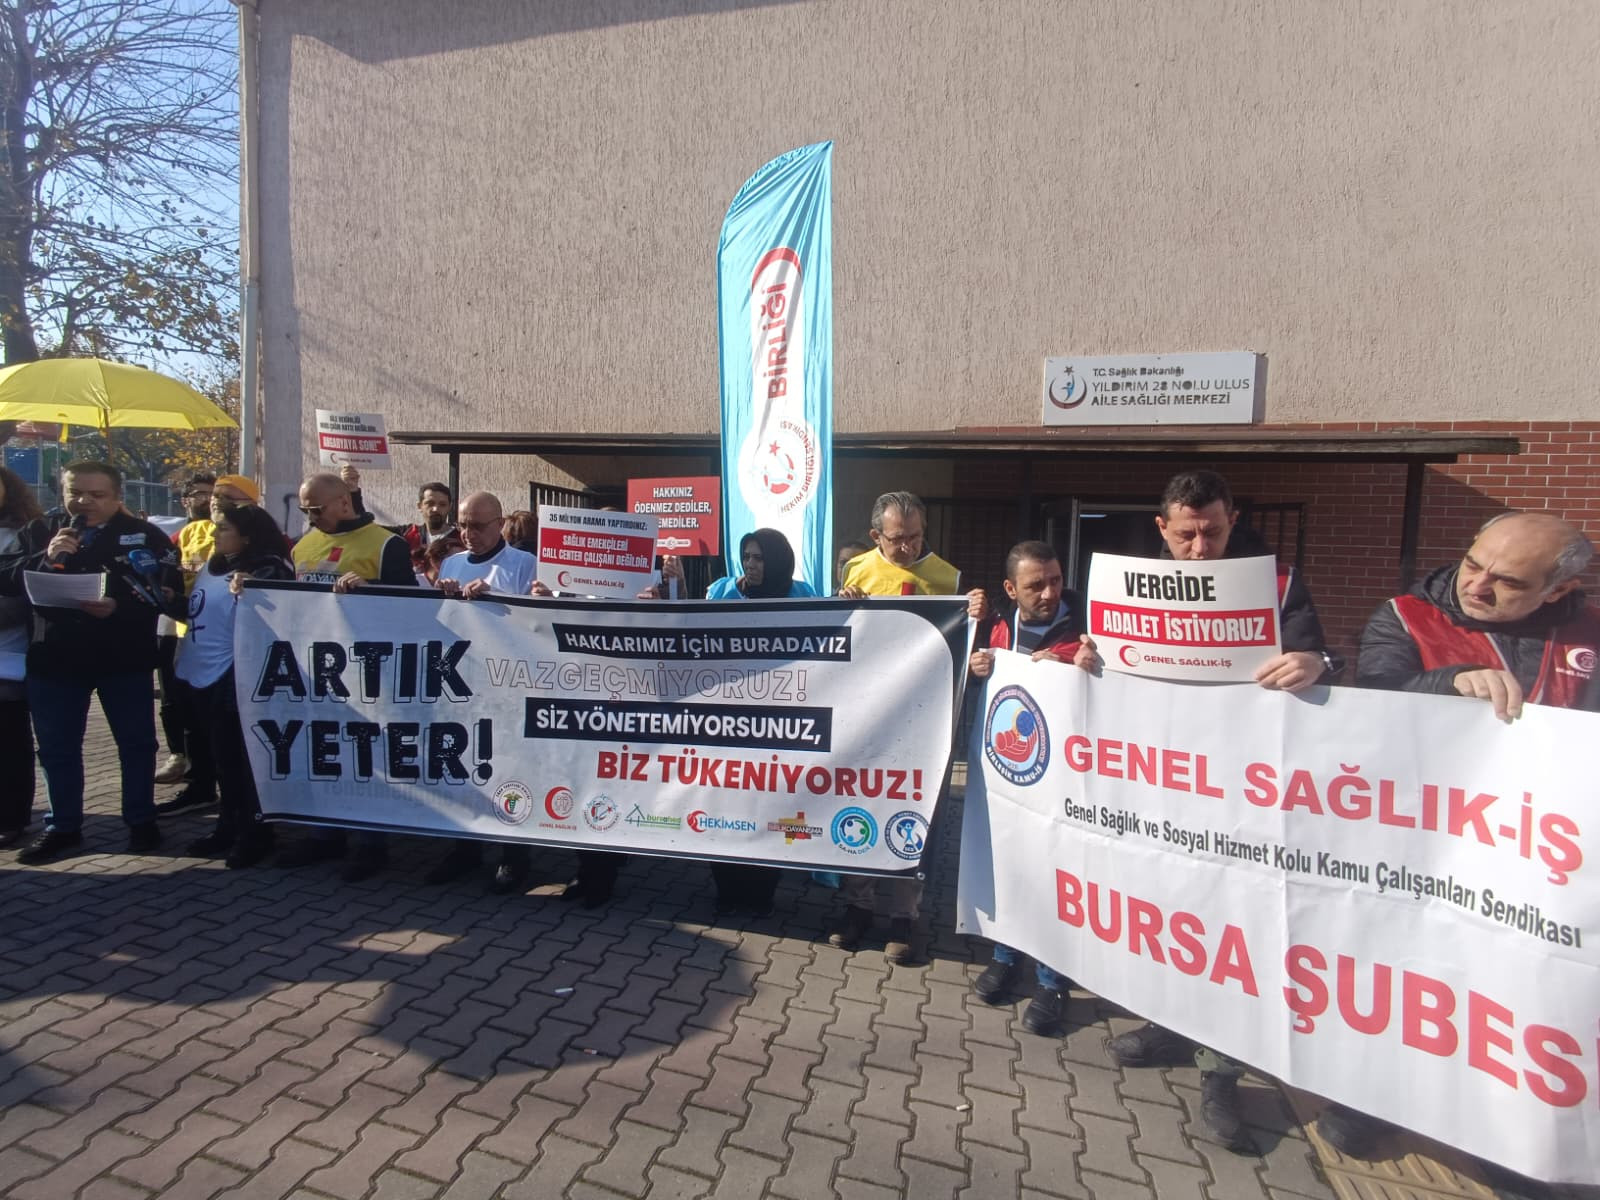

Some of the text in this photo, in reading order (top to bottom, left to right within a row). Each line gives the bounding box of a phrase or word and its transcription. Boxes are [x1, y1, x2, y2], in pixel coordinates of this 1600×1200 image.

[761, 283, 788, 399] BİRLİĞİ
[1108, 367, 1138, 377] Sağlık
[1139, 366, 1184, 377] Bakanlığı
[1092, 381, 1149, 392] YILDIRIM
[1172, 380, 1210, 391] NOLU
[1215, 378, 1250, 389] ULUS
[1091, 392, 1231, 406] AİLE SAĞLIĞI MERKEZİ
[653, 487, 693, 498] HAKKINIZ
[634, 500, 712, 514] ÖDENMEZ DEDİLER,
[549, 513, 558, 522] 35
[559, 513, 582, 524] MİLYON
[582, 516, 606, 527] ARAMA
[658, 516, 699, 529] EMEDİLER.
[562, 534, 629, 553] SAĞLIK EMEKÇİLERİ
[542, 547, 557, 559] CALL
[559, 549, 583, 562] CENTER
[584, 551, 615, 567] ÇALIŞANI
[573, 577, 594, 585] GENEL
[1124, 570, 1217, 602] VERGİDE
[1103, 609, 1266, 642] ADALET İSTİYORUZ
[565, 632, 847, 657] HAKLARIMIZ İÇİN BURADAYIZ
[251, 640, 474, 704] ARTIK
[1144, 654, 1233, 669] GENEL SAĞLIK-İŞ
[485, 658, 808, 703] VAZGEÇMİYORUZ!
[536, 704, 821, 744] SİZ YÖNETEMİYORSUNUZ,
[251, 718, 493, 786] YETER!
[597, 744, 924, 801] BİZ TÜKENİYORUZ!
[1063, 734, 1584, 886] GENEL SAĞLIK-İŞ
[700, 816, 756, 831] HEKİMSEN
[1064, 798, 1582, 949] Genel Sağlık ve Sosyal Hizmet Kolu Kamu Çalışanları Sendikası
[1055, 867, 1600, 1108] BURSA ŞUBES
